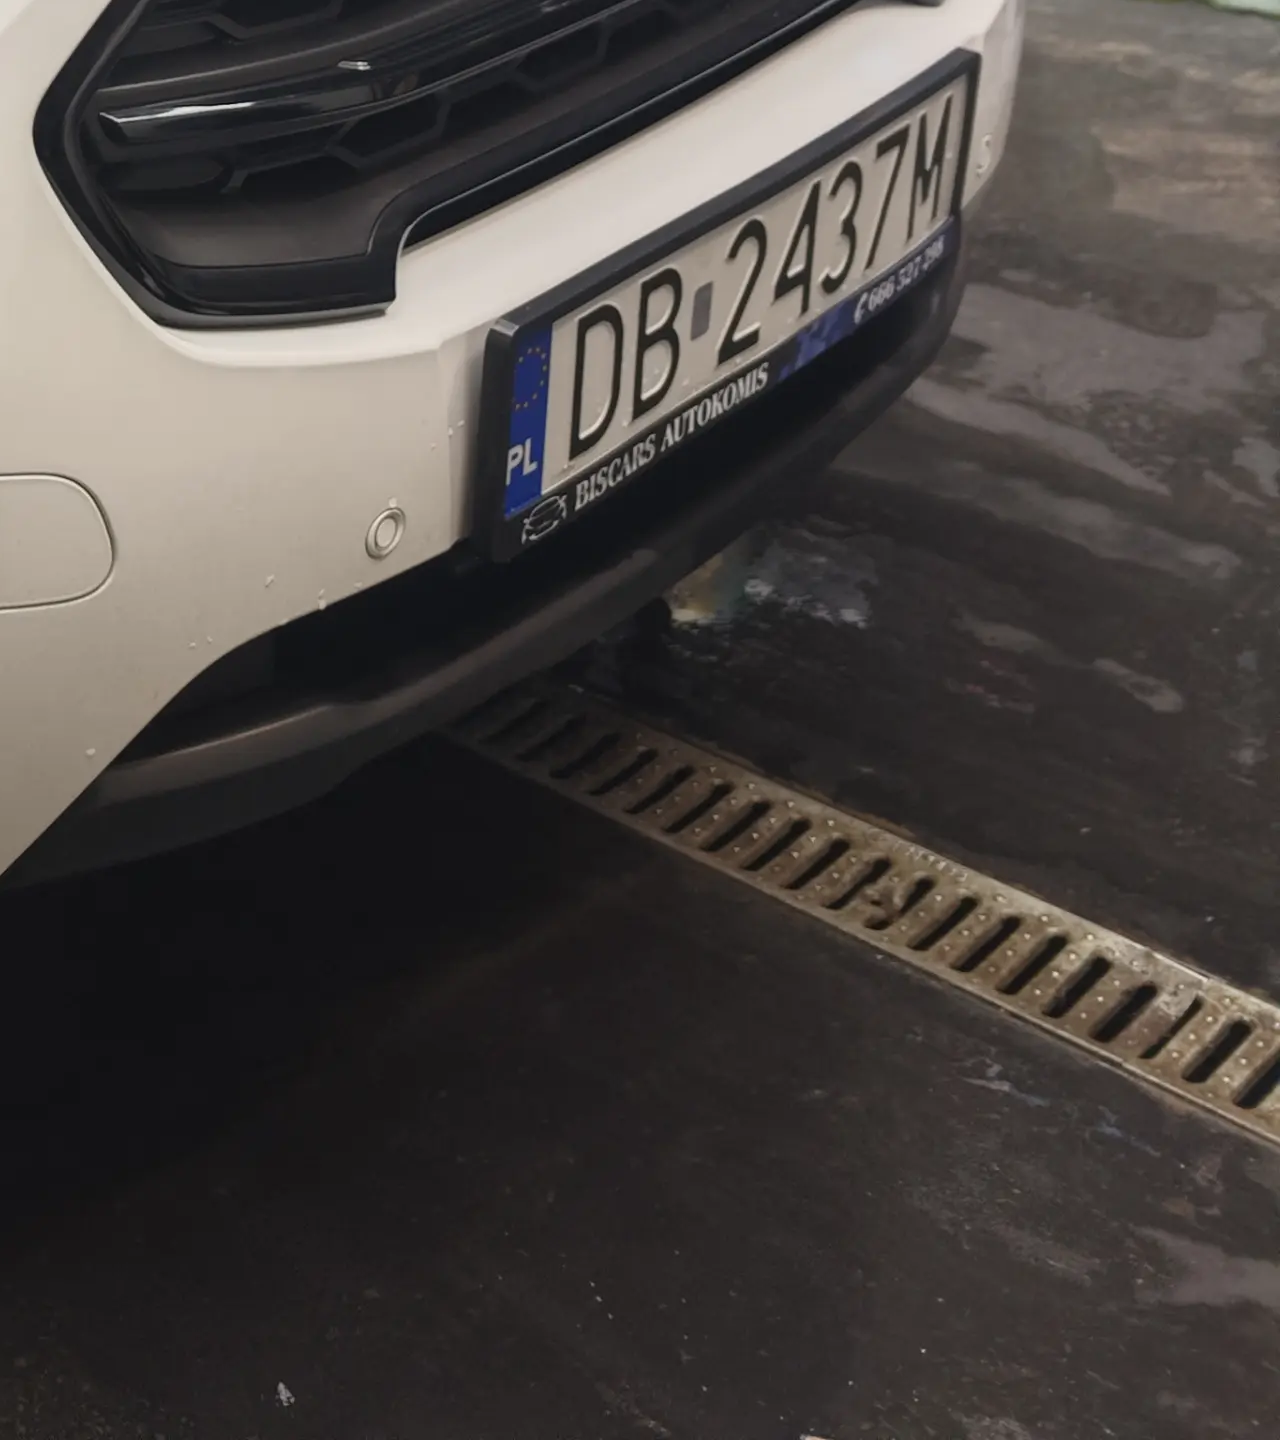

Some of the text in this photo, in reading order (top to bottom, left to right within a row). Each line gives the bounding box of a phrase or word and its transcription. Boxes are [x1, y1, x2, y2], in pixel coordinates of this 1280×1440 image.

[568, 93, 955, 462] DB 2437M
[506, 439, 539, 485] PL
[574, 362, 769, 511] BISCARS AUTOKOMIS
